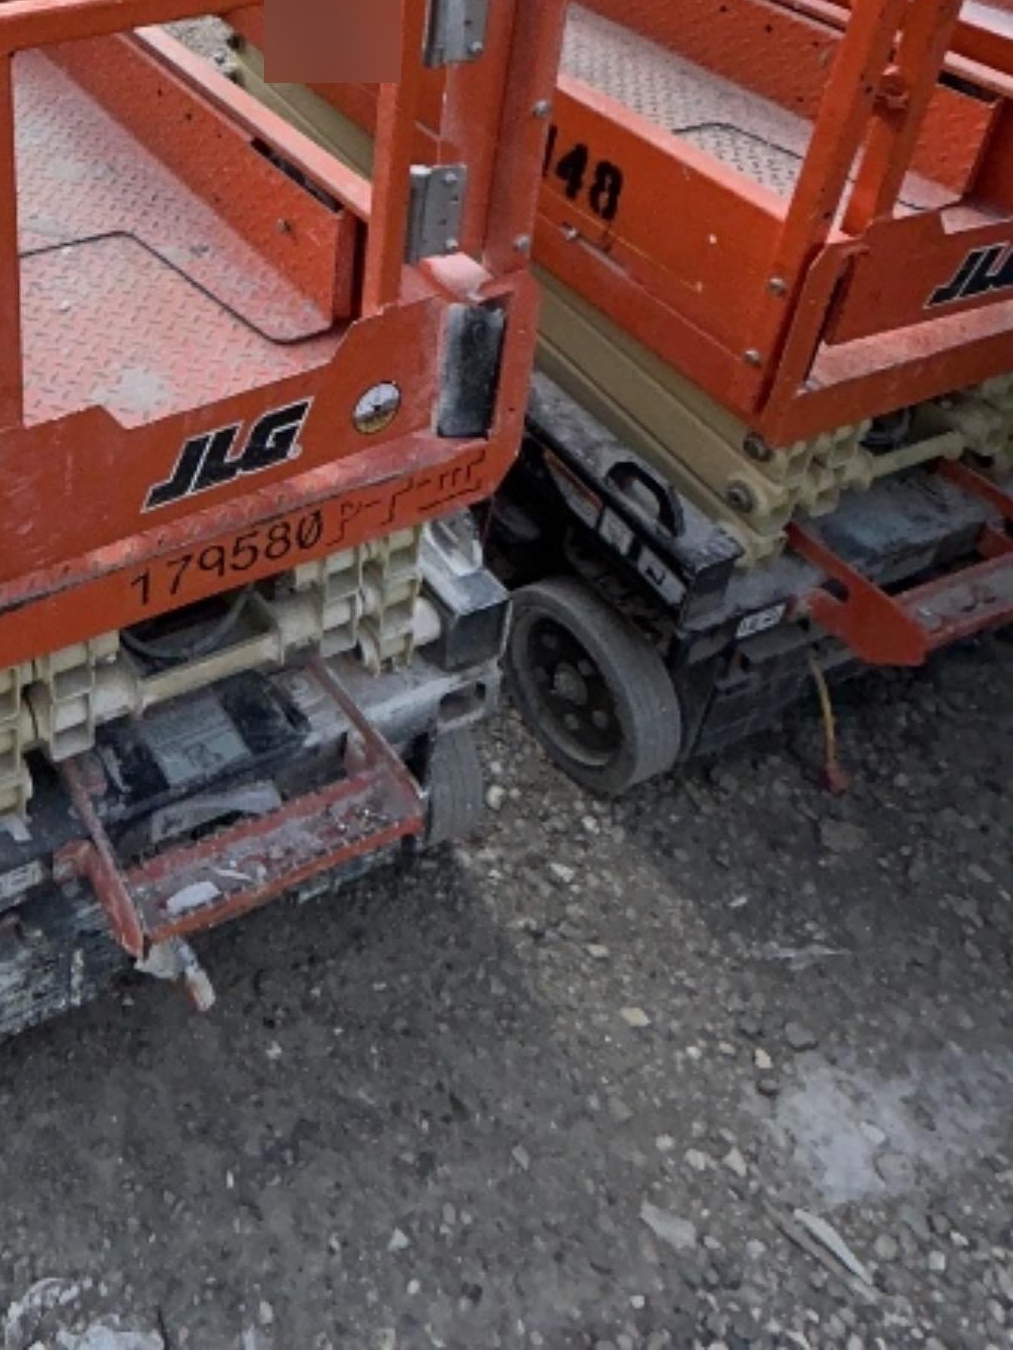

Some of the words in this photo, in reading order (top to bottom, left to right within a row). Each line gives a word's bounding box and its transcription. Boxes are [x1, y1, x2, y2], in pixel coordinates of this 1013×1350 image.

[923, 241, 1013, 310] JL
[139, 395, 315, 515] JLG
[130, 509, 324, 605] 179580
